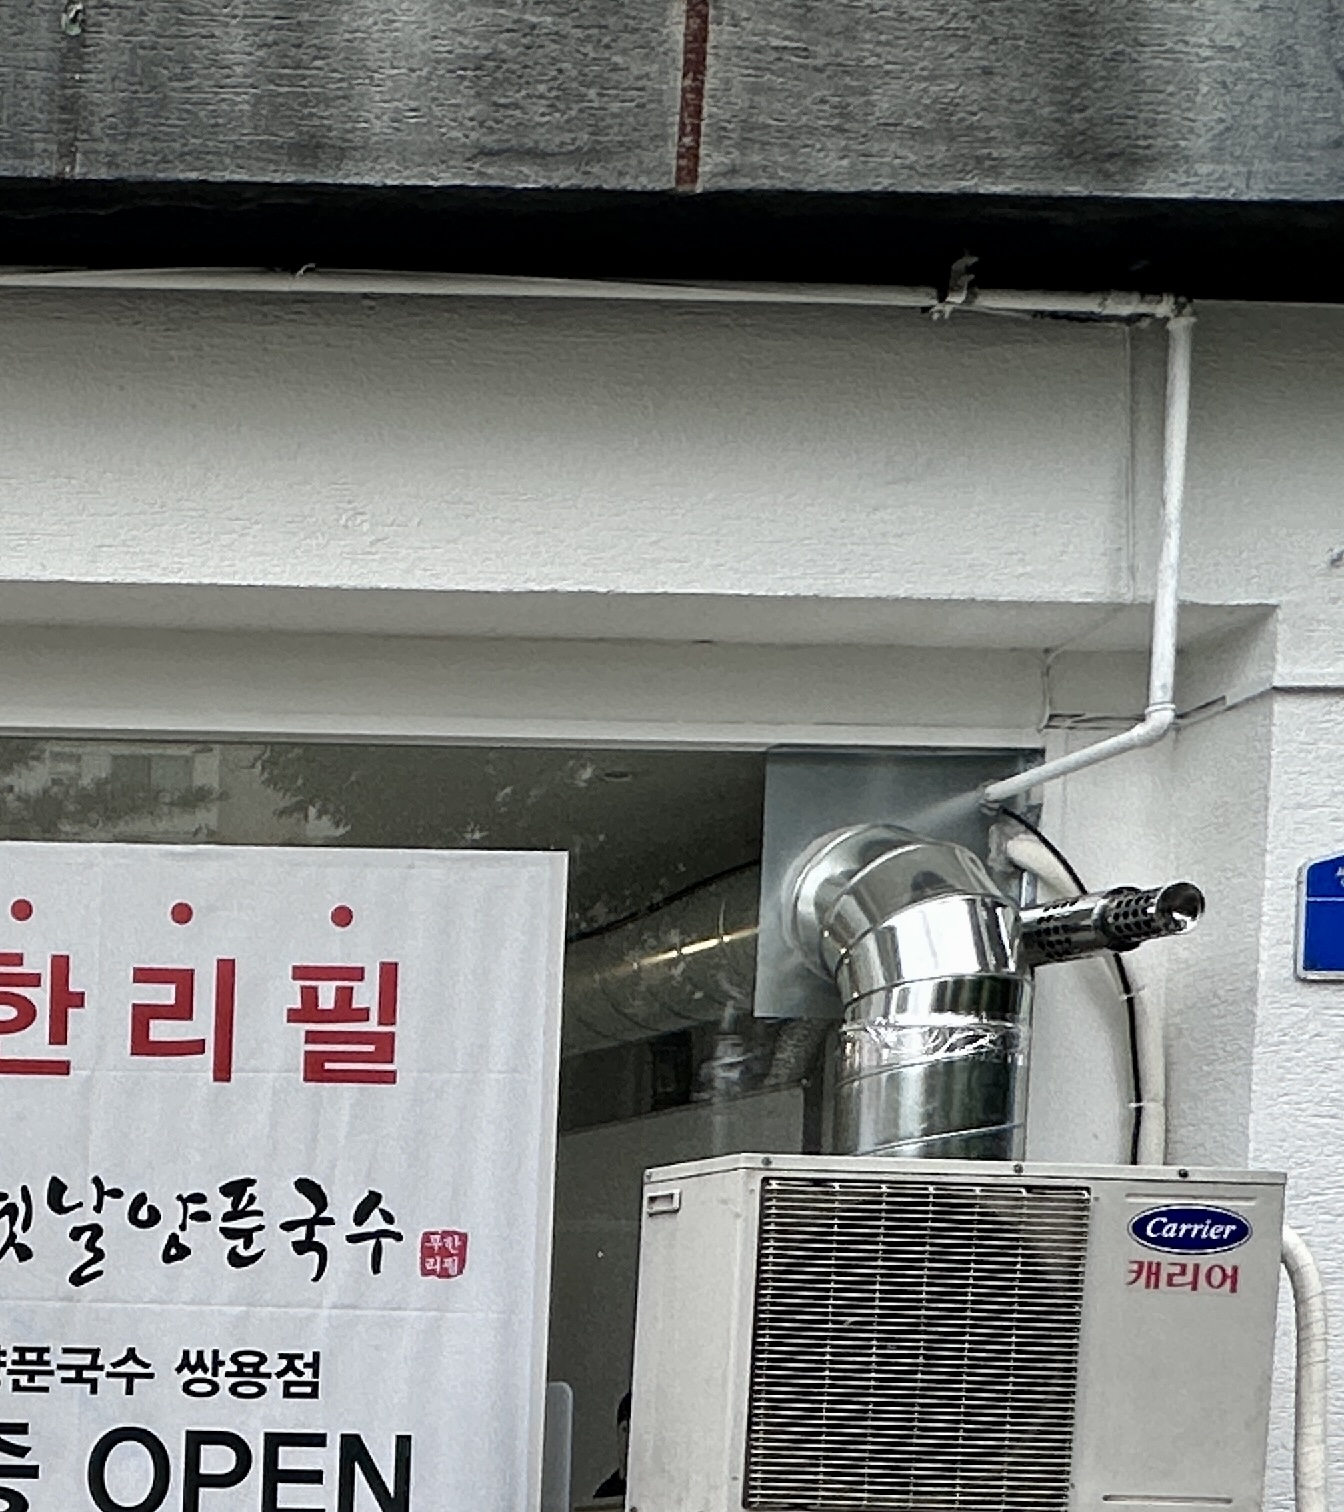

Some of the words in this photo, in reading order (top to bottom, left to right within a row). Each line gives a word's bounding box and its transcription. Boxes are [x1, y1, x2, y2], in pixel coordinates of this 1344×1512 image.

[1143, 1215, 1238, 1243] Carrier
[1125, 1258, 1241, 1294] 캐리어
[175, 1347, 323, 1402] 쌍용점
